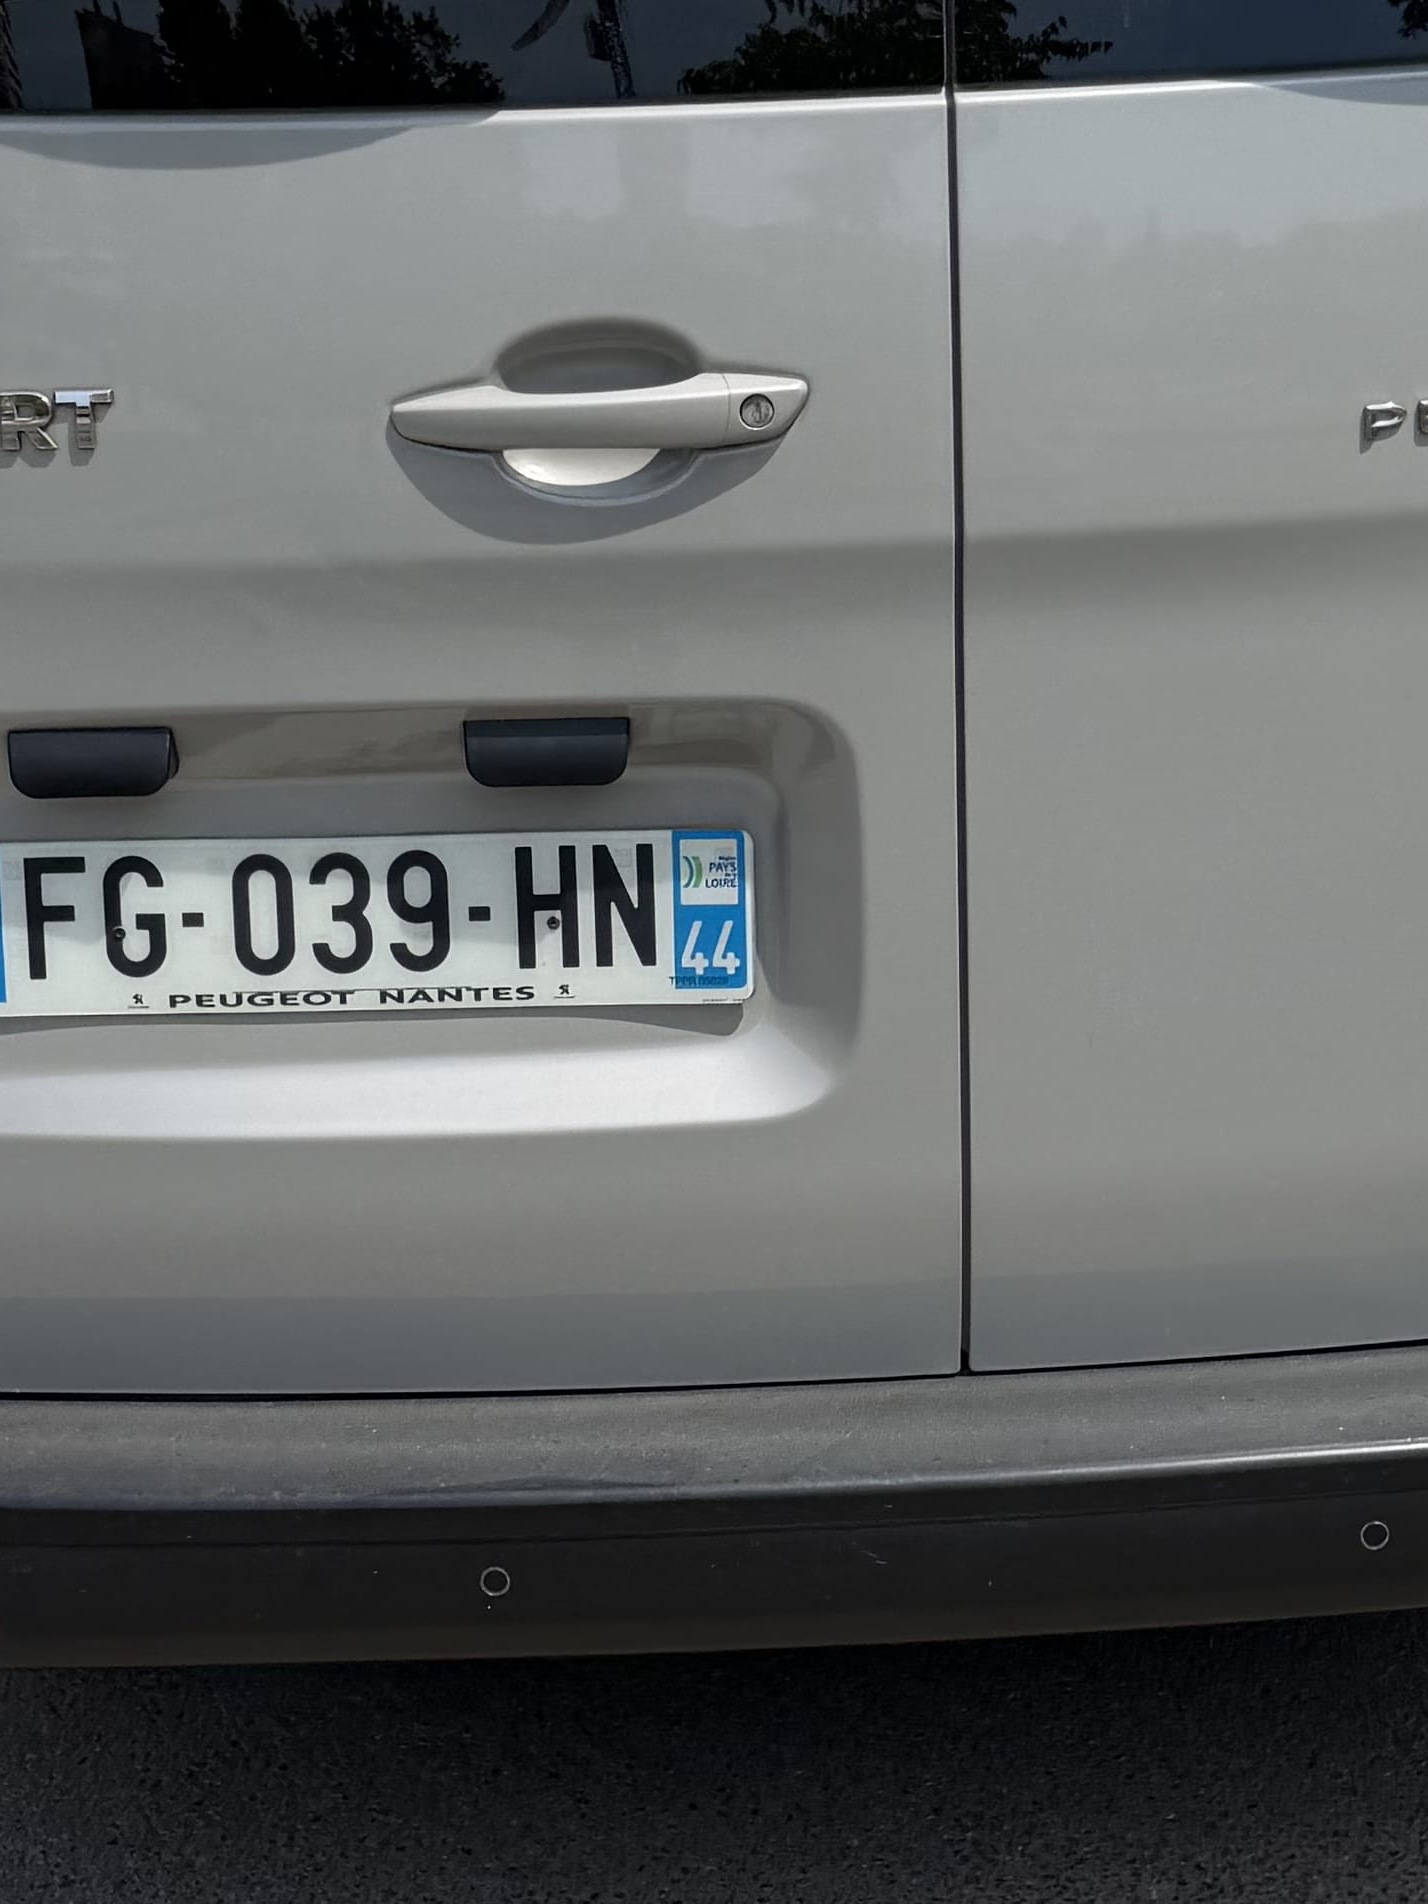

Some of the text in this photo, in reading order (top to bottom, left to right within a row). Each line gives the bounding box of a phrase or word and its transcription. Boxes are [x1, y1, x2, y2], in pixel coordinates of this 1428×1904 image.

[22, 843, 657, 980] FG-039-HN
[681, 920, 740, 975] 44
[168, 985, 536, 1009] PEUGEOT NANTES
